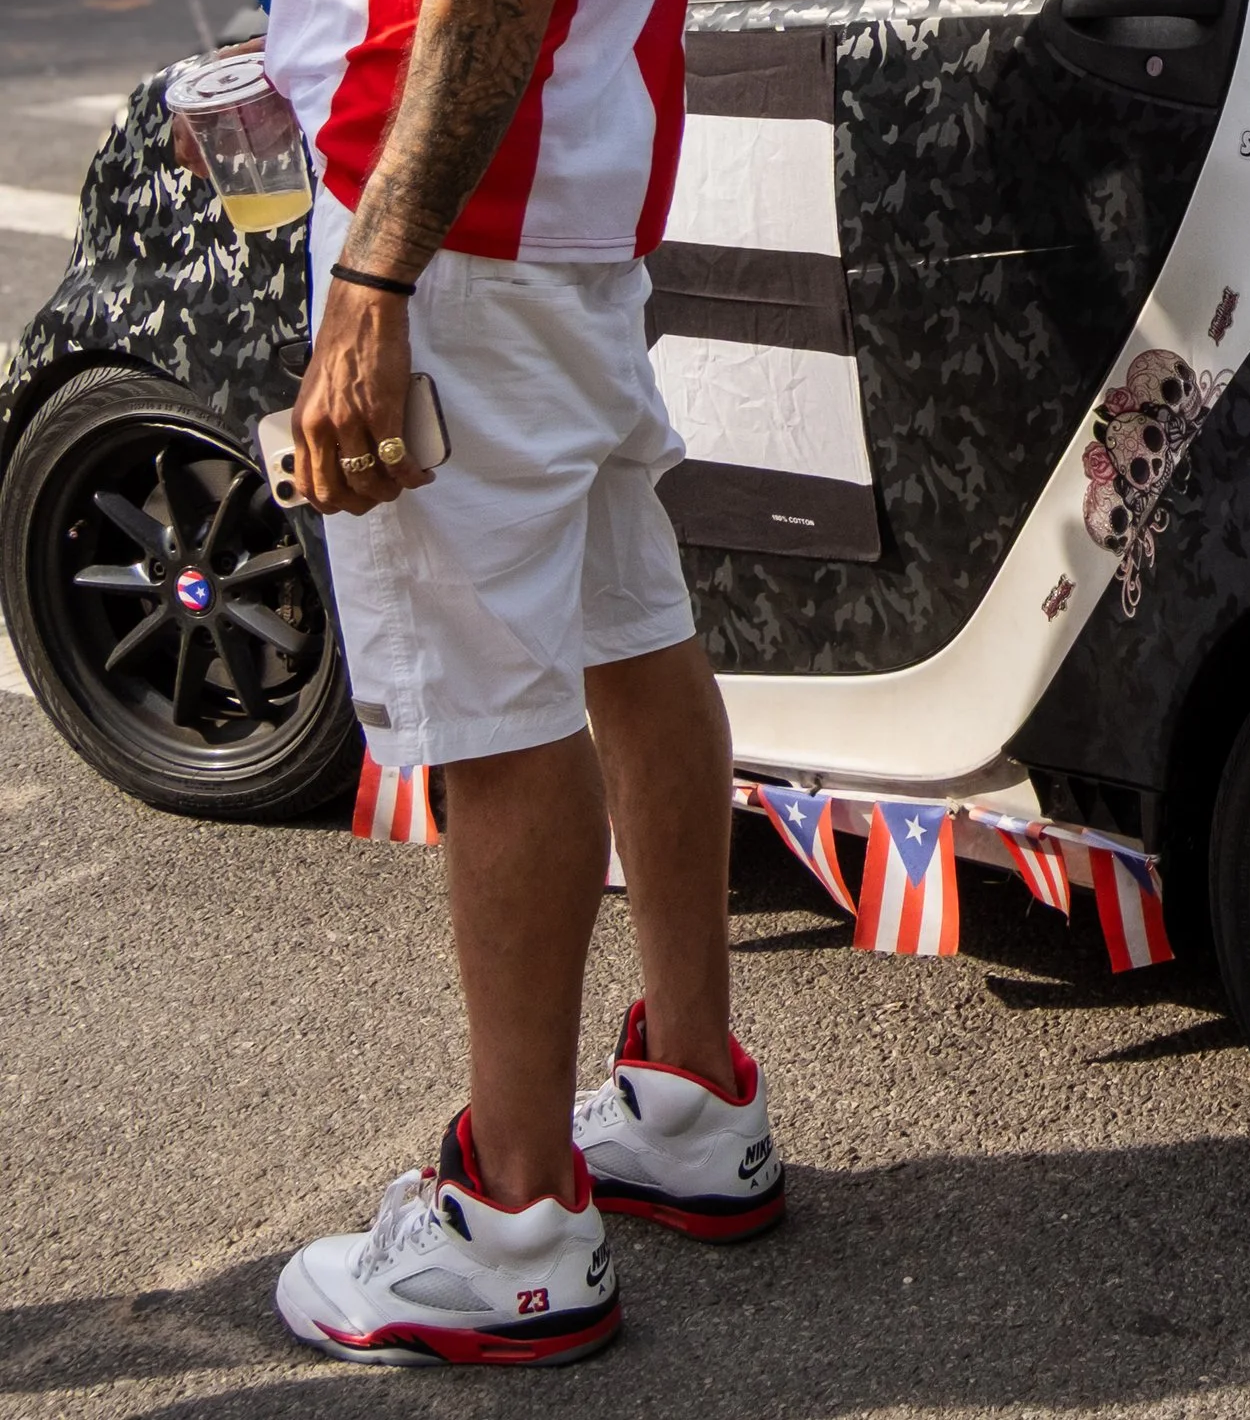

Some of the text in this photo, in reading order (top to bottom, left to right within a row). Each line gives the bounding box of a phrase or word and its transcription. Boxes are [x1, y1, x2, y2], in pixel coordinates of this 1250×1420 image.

[772, 514, 815, 526] 100% COTTON
[517, 1288, 549, 1314] 23
